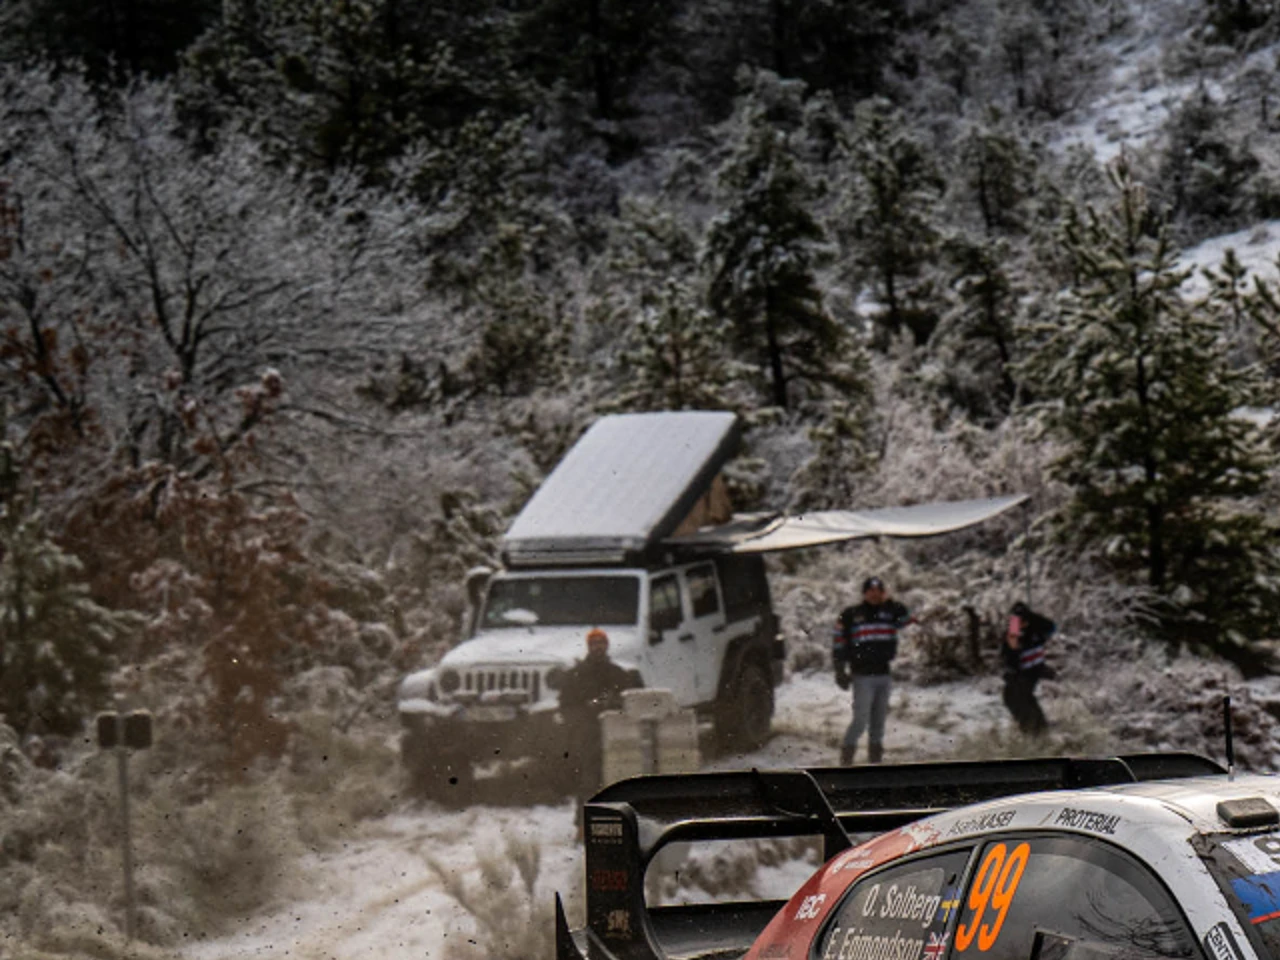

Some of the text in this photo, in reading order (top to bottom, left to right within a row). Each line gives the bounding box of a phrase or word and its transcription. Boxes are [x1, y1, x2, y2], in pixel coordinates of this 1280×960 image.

[1054, 807, 1122, 834] PROTERIAL
[862, 883, 942, 929] O. Solberg
[954, 841, 1031, 952] 99
[824, 927, 837, 960] E.
